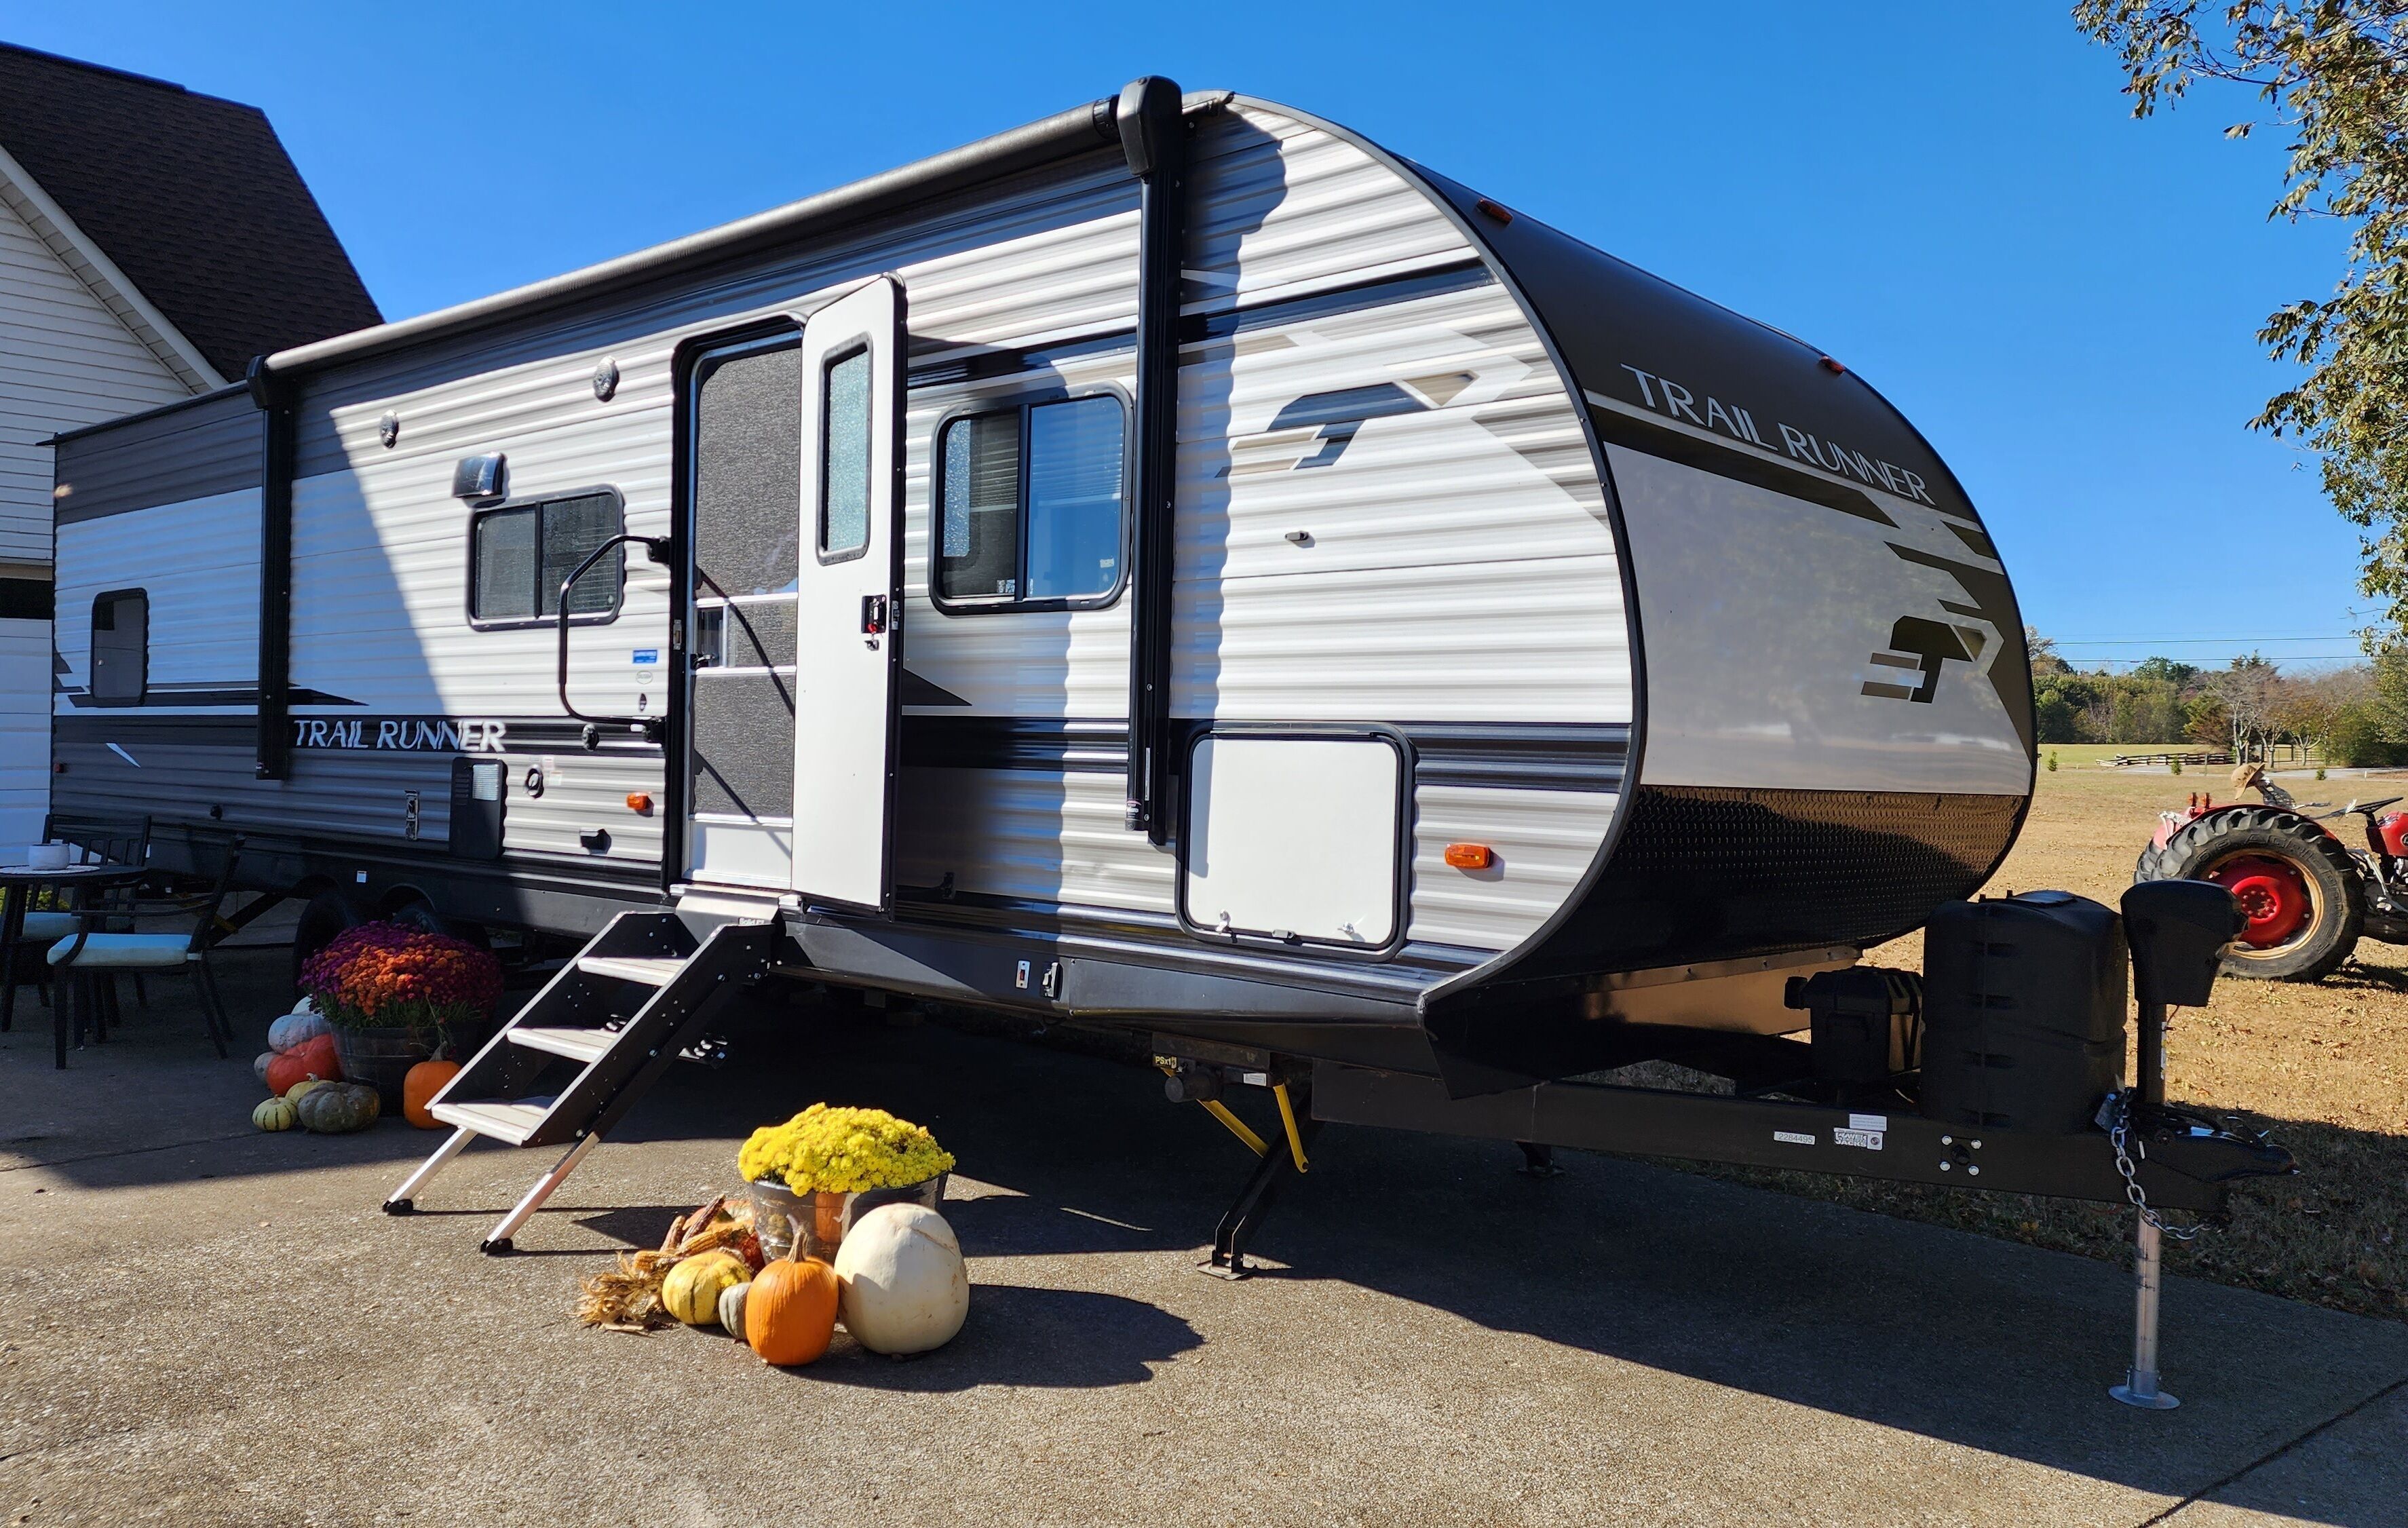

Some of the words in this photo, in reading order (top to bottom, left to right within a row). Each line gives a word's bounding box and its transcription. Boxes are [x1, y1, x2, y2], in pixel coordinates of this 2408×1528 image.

[1620, 363, 1778, 451] TRAIL
[1777, 422, 1936, 506] RUNNER
[293, 719, 369, 748] TRAIL
[376, 720, 508, 753] RUNNER
[1778, 1132, 1814, 1143] 2284495
